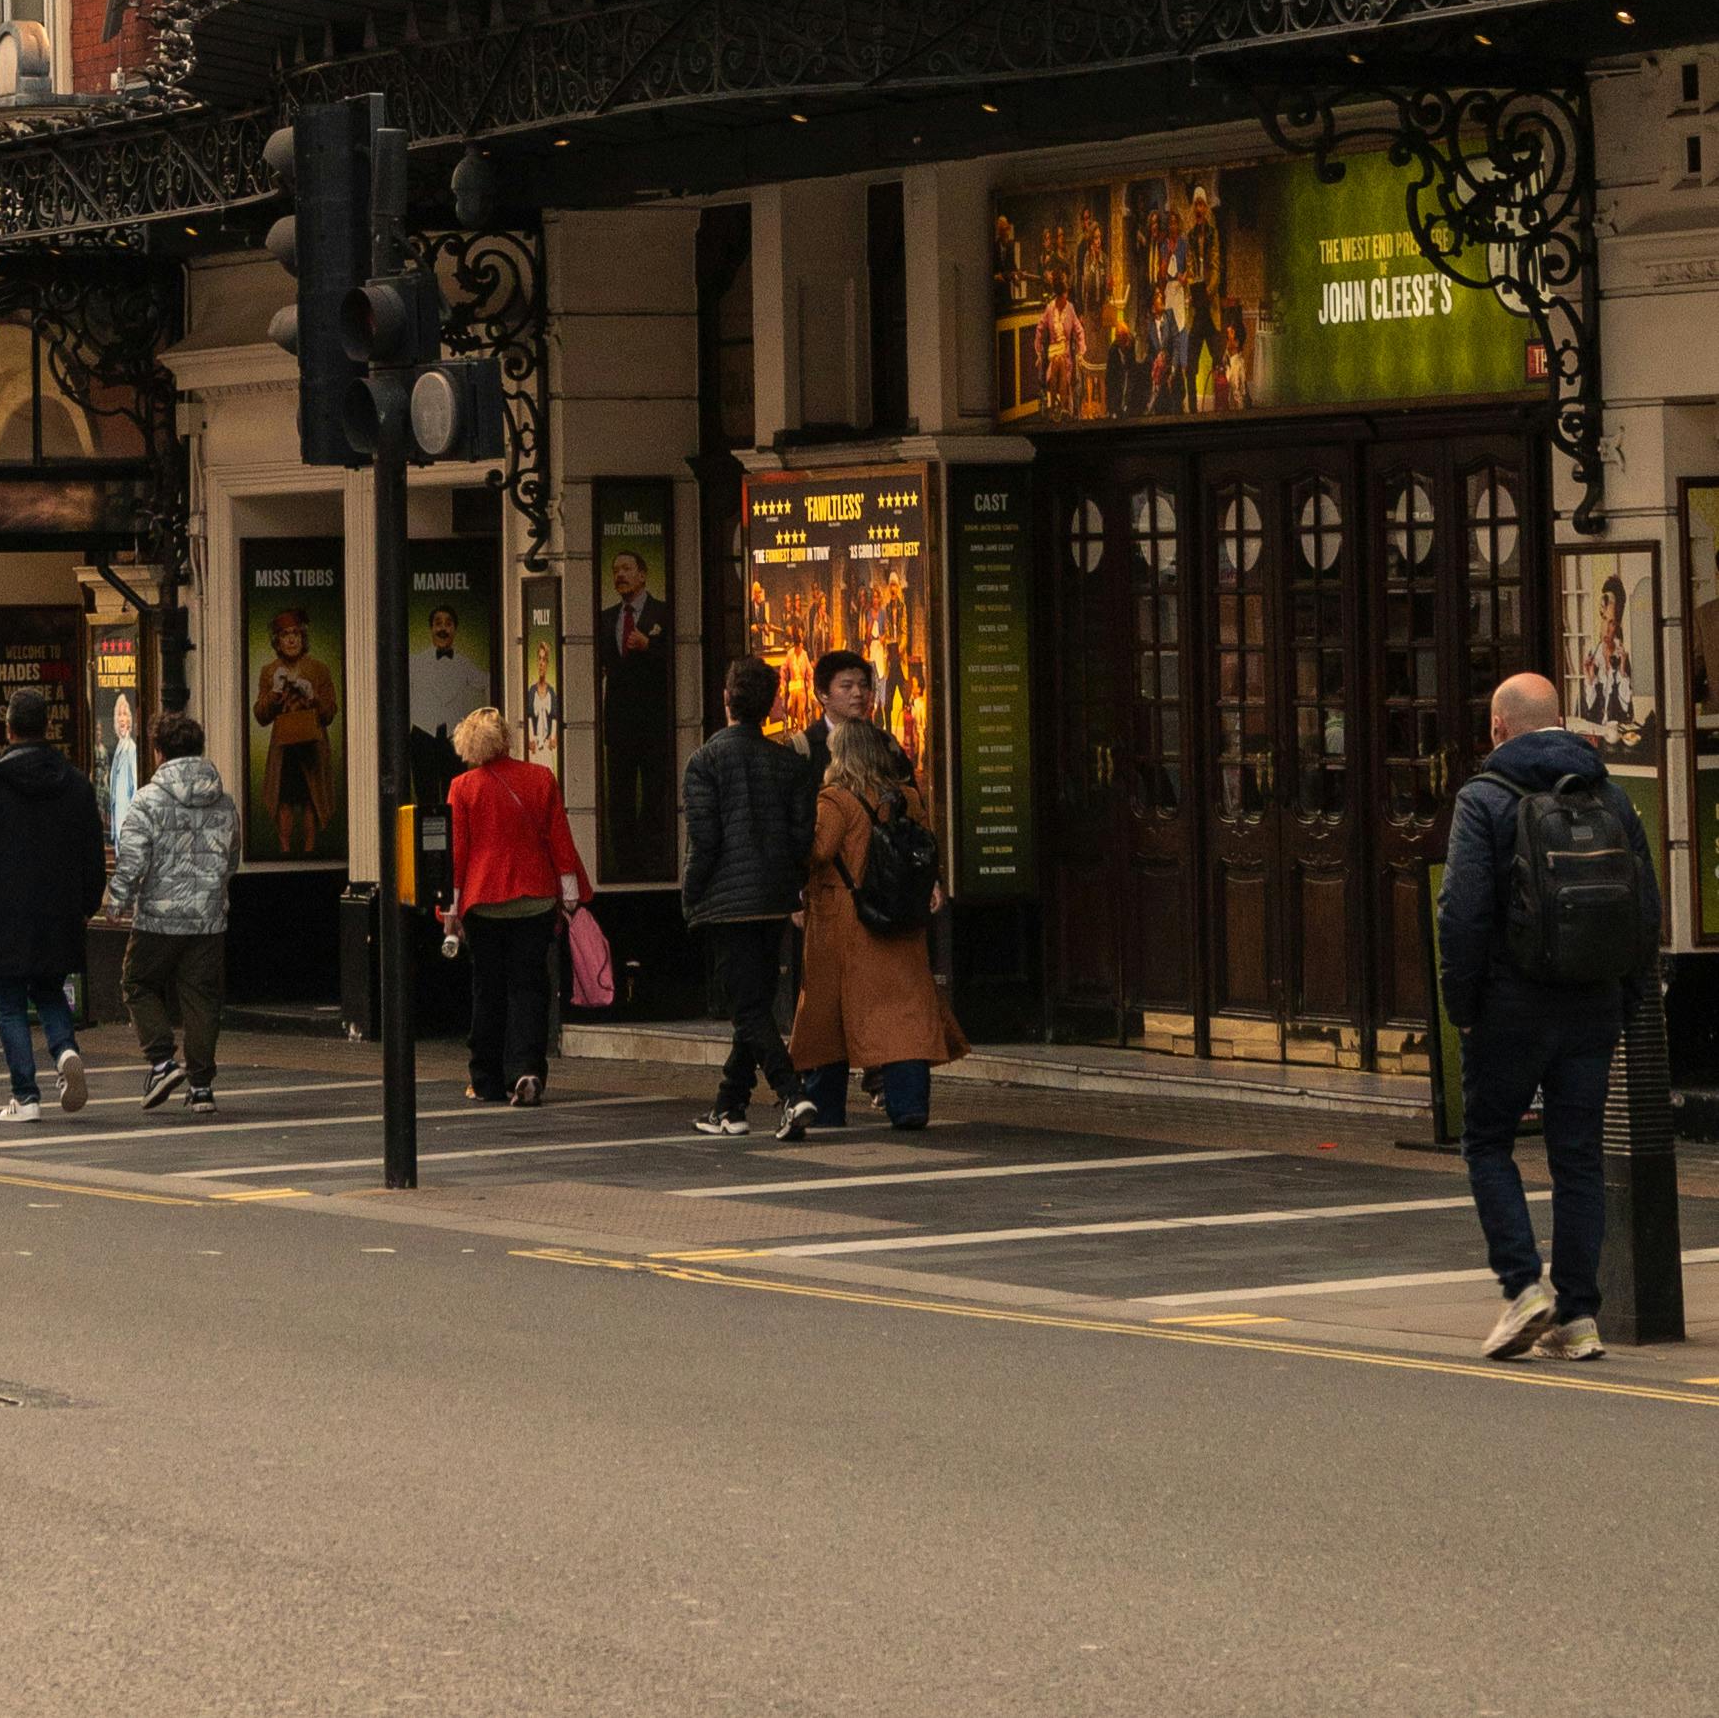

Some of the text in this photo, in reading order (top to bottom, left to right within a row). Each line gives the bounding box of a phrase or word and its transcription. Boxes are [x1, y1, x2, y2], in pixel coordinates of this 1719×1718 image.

[1319, 239, 1340, 264] THE
[1341, 234, 1370, 261] WEST
[1372, 232, 1394, 258] END
[1318, 272, 1453, 325] JOHN CLEESE'S
[973, 493, 1009, 513] CAST
[603, 523, 662, 537] HUTCHINSON
[255, 568, 334, 588] MISS TIBBS
[413, 572, 470, 592] MANUEL
[533, 609, 551, 626] POLLY
